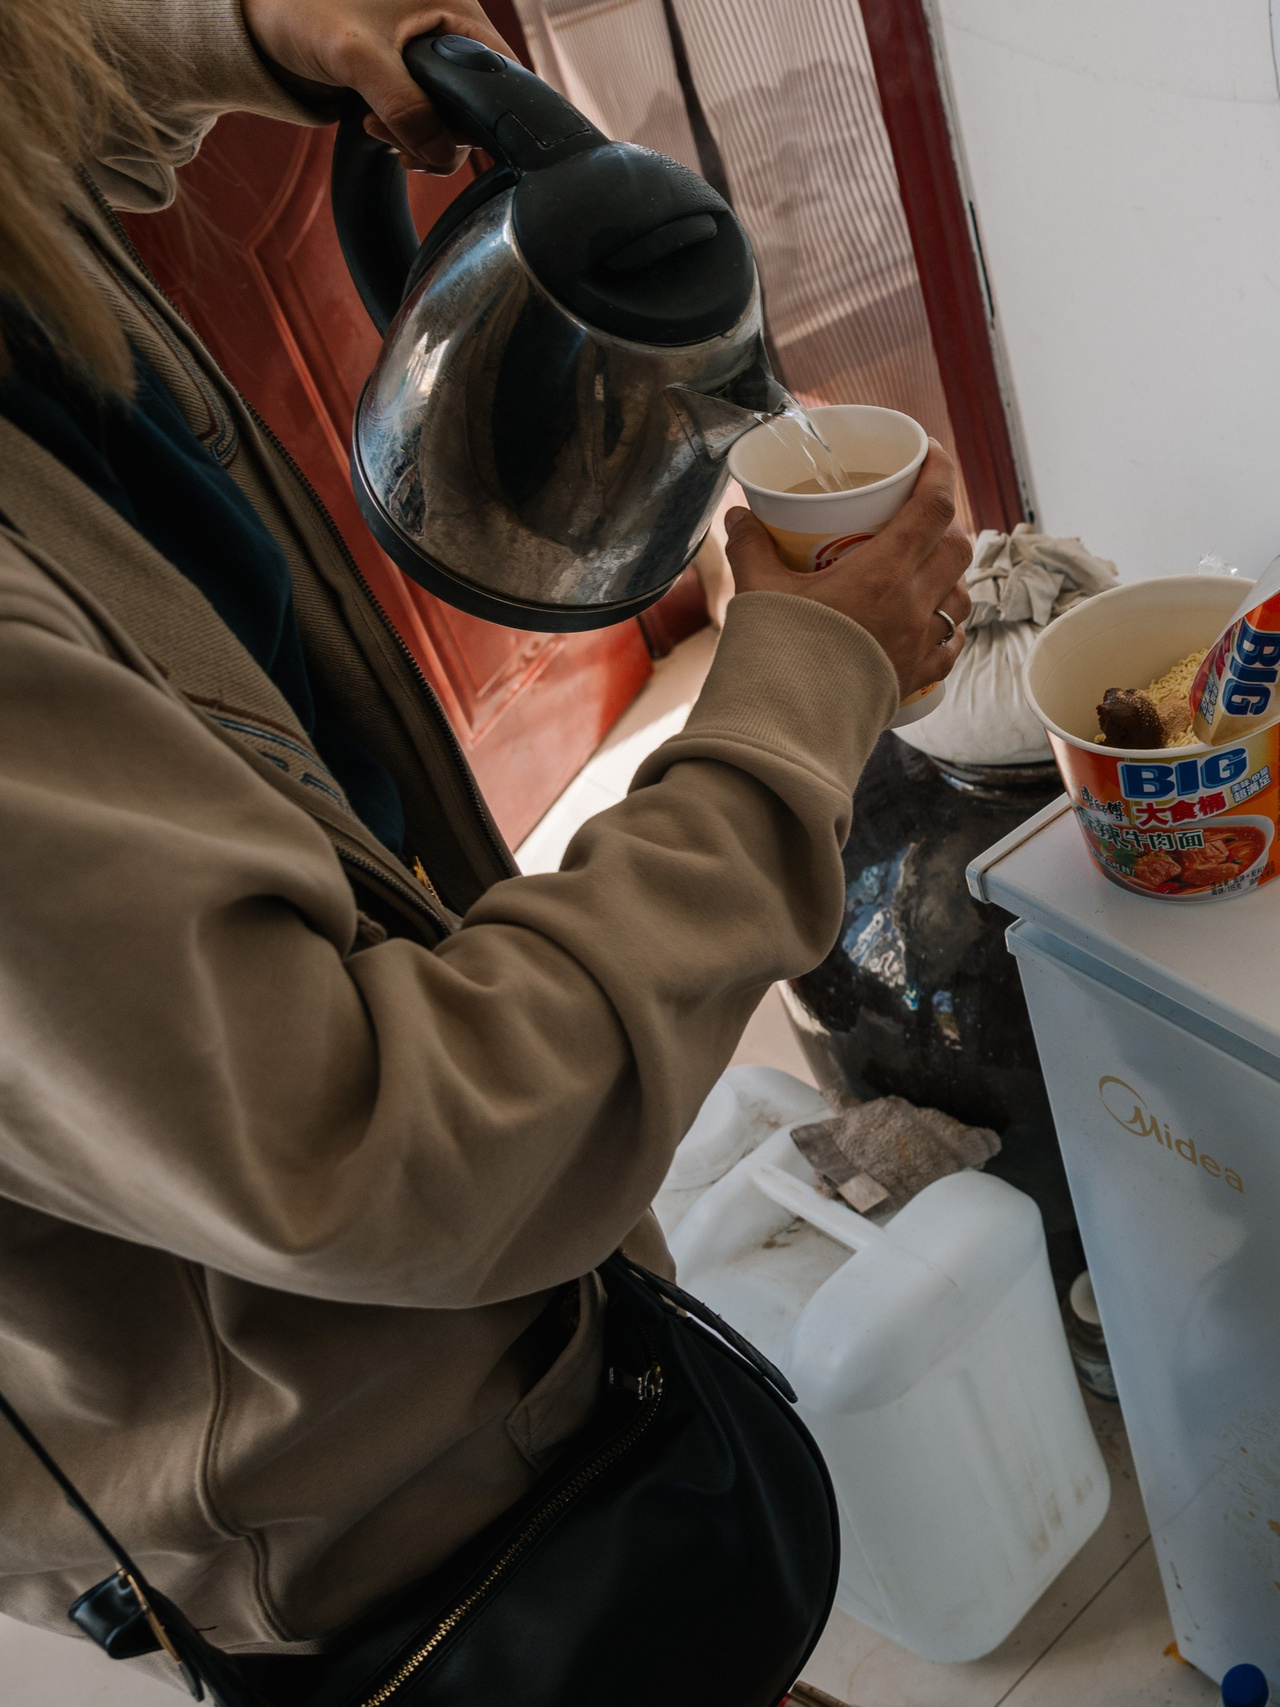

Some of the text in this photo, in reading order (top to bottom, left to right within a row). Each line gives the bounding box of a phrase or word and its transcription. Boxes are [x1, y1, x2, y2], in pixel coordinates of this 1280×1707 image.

[1119, 747, 1247, 799] BIG
[1135, 791, 1228, 828] 大食桶
[1118, 1104, 1244, 1194] Midea
